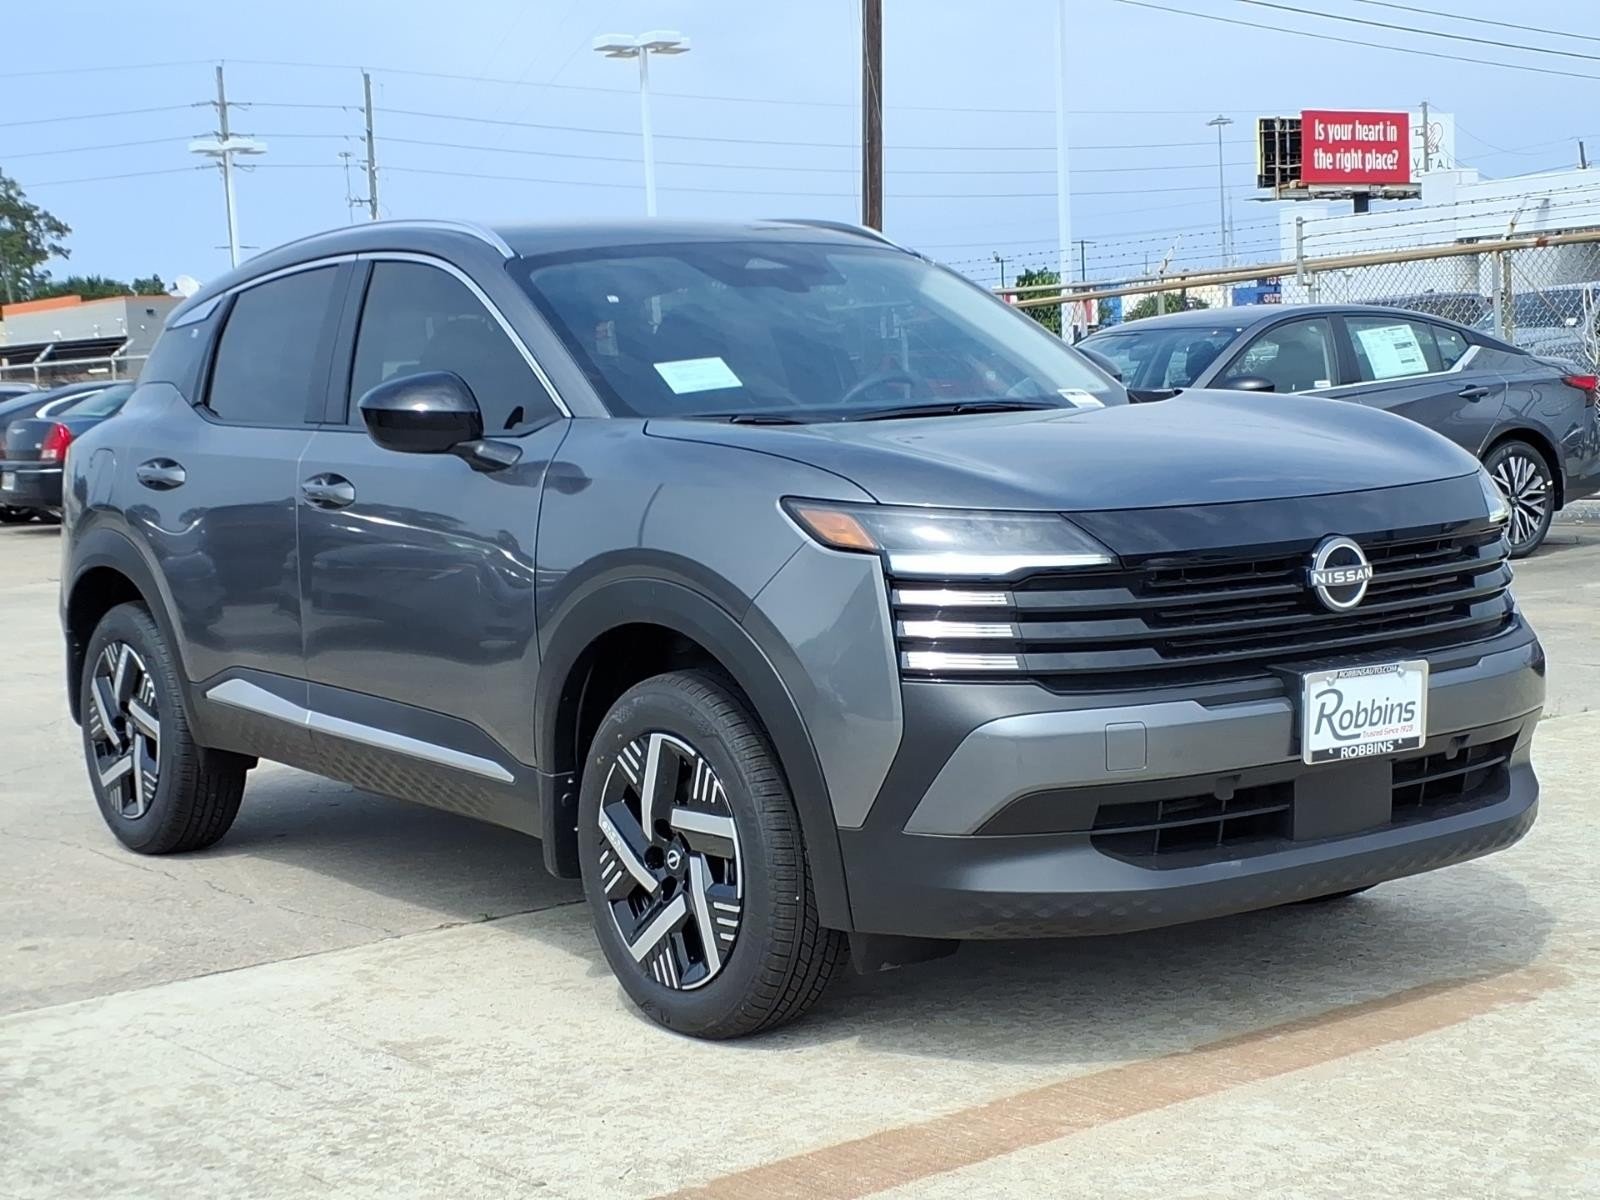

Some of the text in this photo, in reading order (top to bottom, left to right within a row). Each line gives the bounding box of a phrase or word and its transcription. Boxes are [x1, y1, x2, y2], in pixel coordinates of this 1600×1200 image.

[1315, 119, 1397, 144] Is your heart in
[1314, 148, 1399, 173] the right place?
[1413, 158, 1452, 170] VTAL
[1313, 565, 1373, 584] NISSAN
[1314, 688, 1416, 741] Robbins
[1341, 741, 1394, 758] ROBBINS
